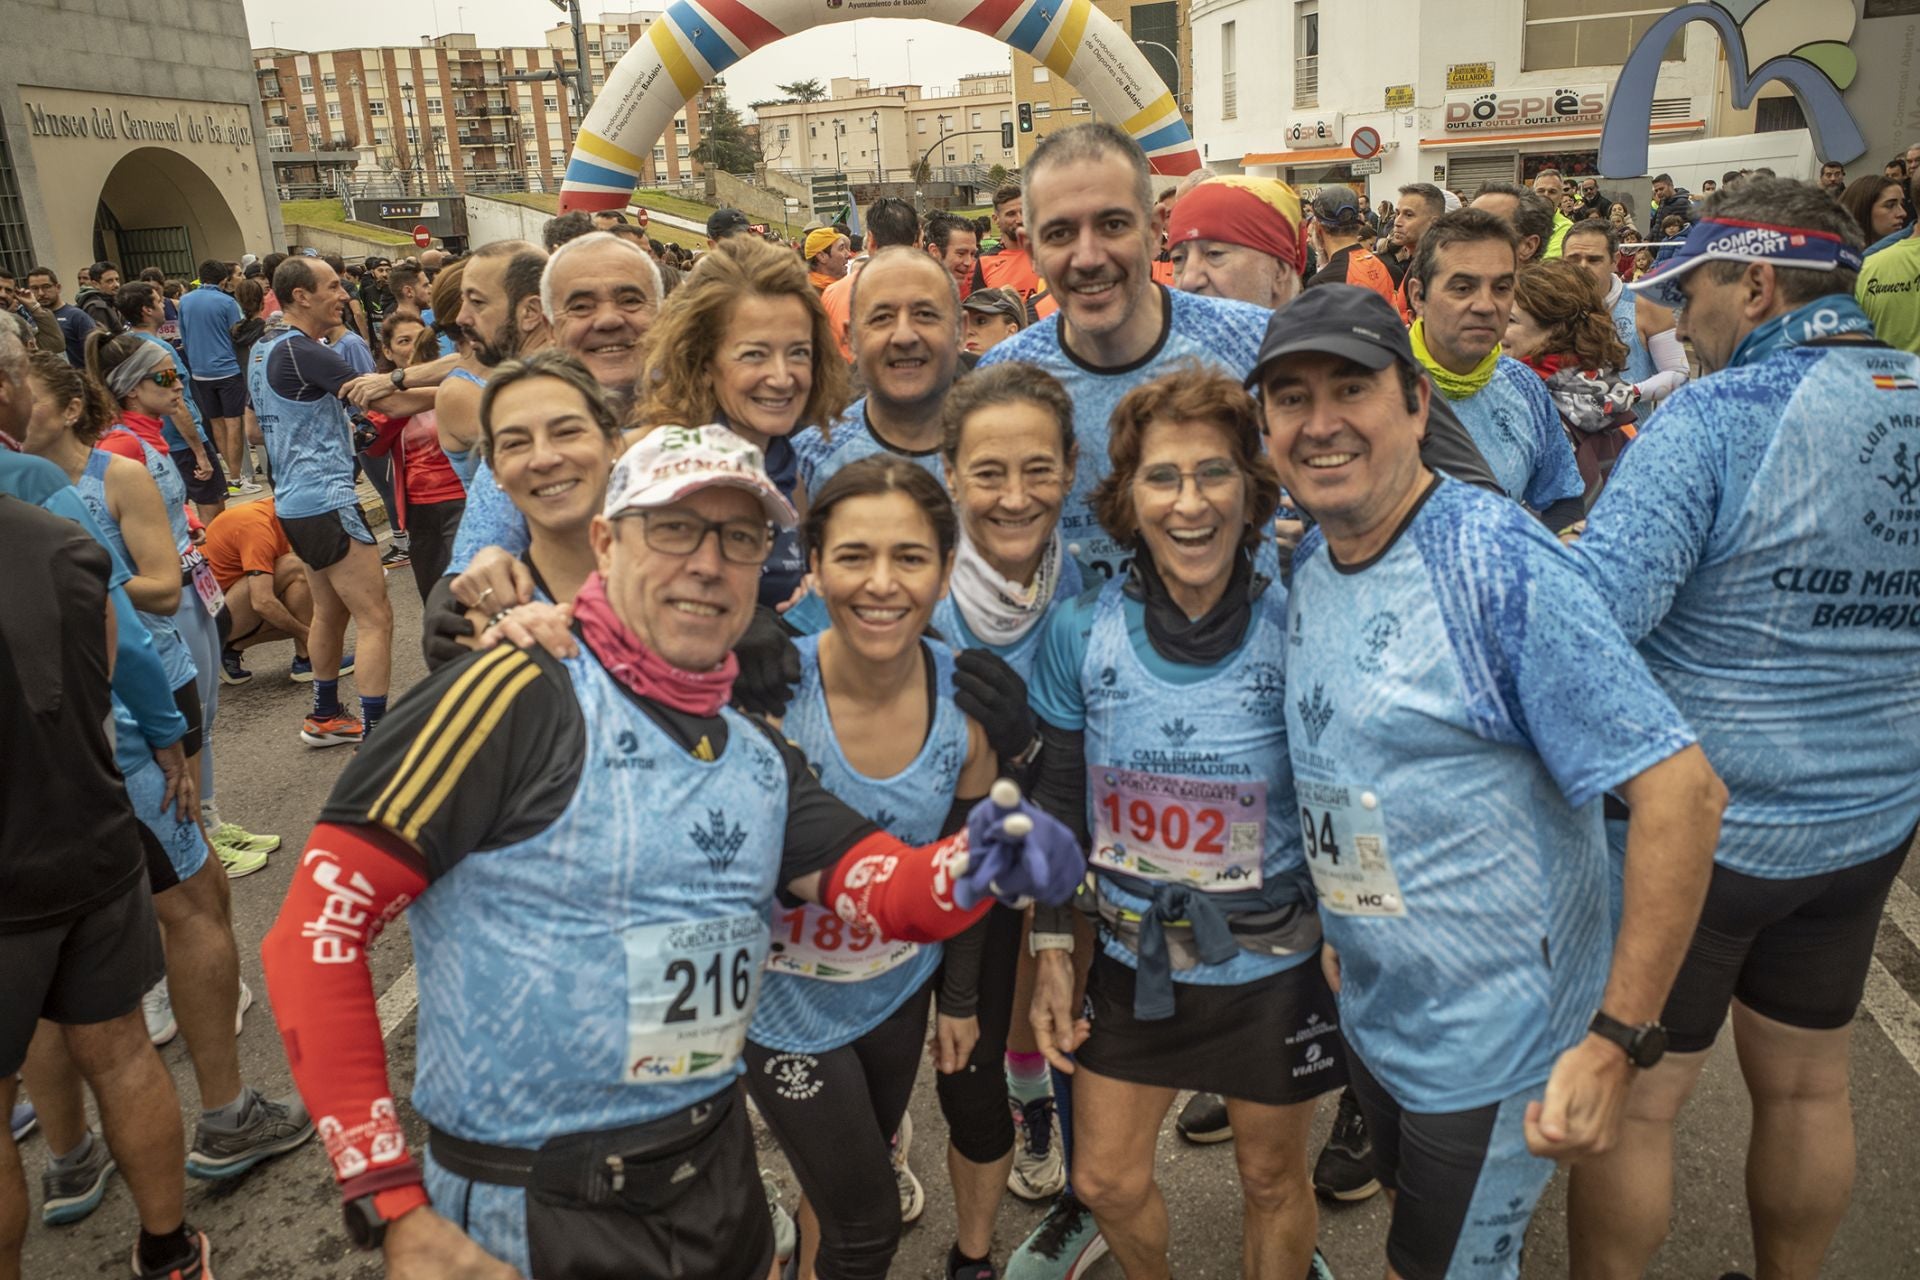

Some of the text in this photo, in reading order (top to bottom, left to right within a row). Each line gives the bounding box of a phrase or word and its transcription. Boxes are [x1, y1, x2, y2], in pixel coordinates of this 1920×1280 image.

[848, 1, 891, 9] Ayuntamiento
[1085, 40, 1145, 111] de Deportes de Badajoz
[1092, 33, 1142, 92] Fundación Municipal
[1452, 73, 1488, 82] GALLARDO
[602, 70, 646, 136] Fundación Municipal
[610, 63, 663, 142] de Deportes de Badajoz
[25, 102, 252, 152] Museo del Carnaval de Badajoz
[1447, 113, 1604, 129] OUTLET OUTLET OUTLET OUTLET
[1867, 278, 1911, 297] Runners
[1859, 421, 1889, 464] CLUB
[1062, 515, 1082, 529] DE
[1772, 566, 1920, 598] CLUB MAR
[1130, 761, 1251, 776] EXTREMADURA
[1132, 750, 1223, 763] CAJA RURAL
[1102, 791, 1226, 855] 1902
[1356, 893, 1386, 907] HO
[782, 907, 885, 952] 189
[662, 948, 751, 1024] 216
[1292, 1056, 1334, 1078] VIATOR
